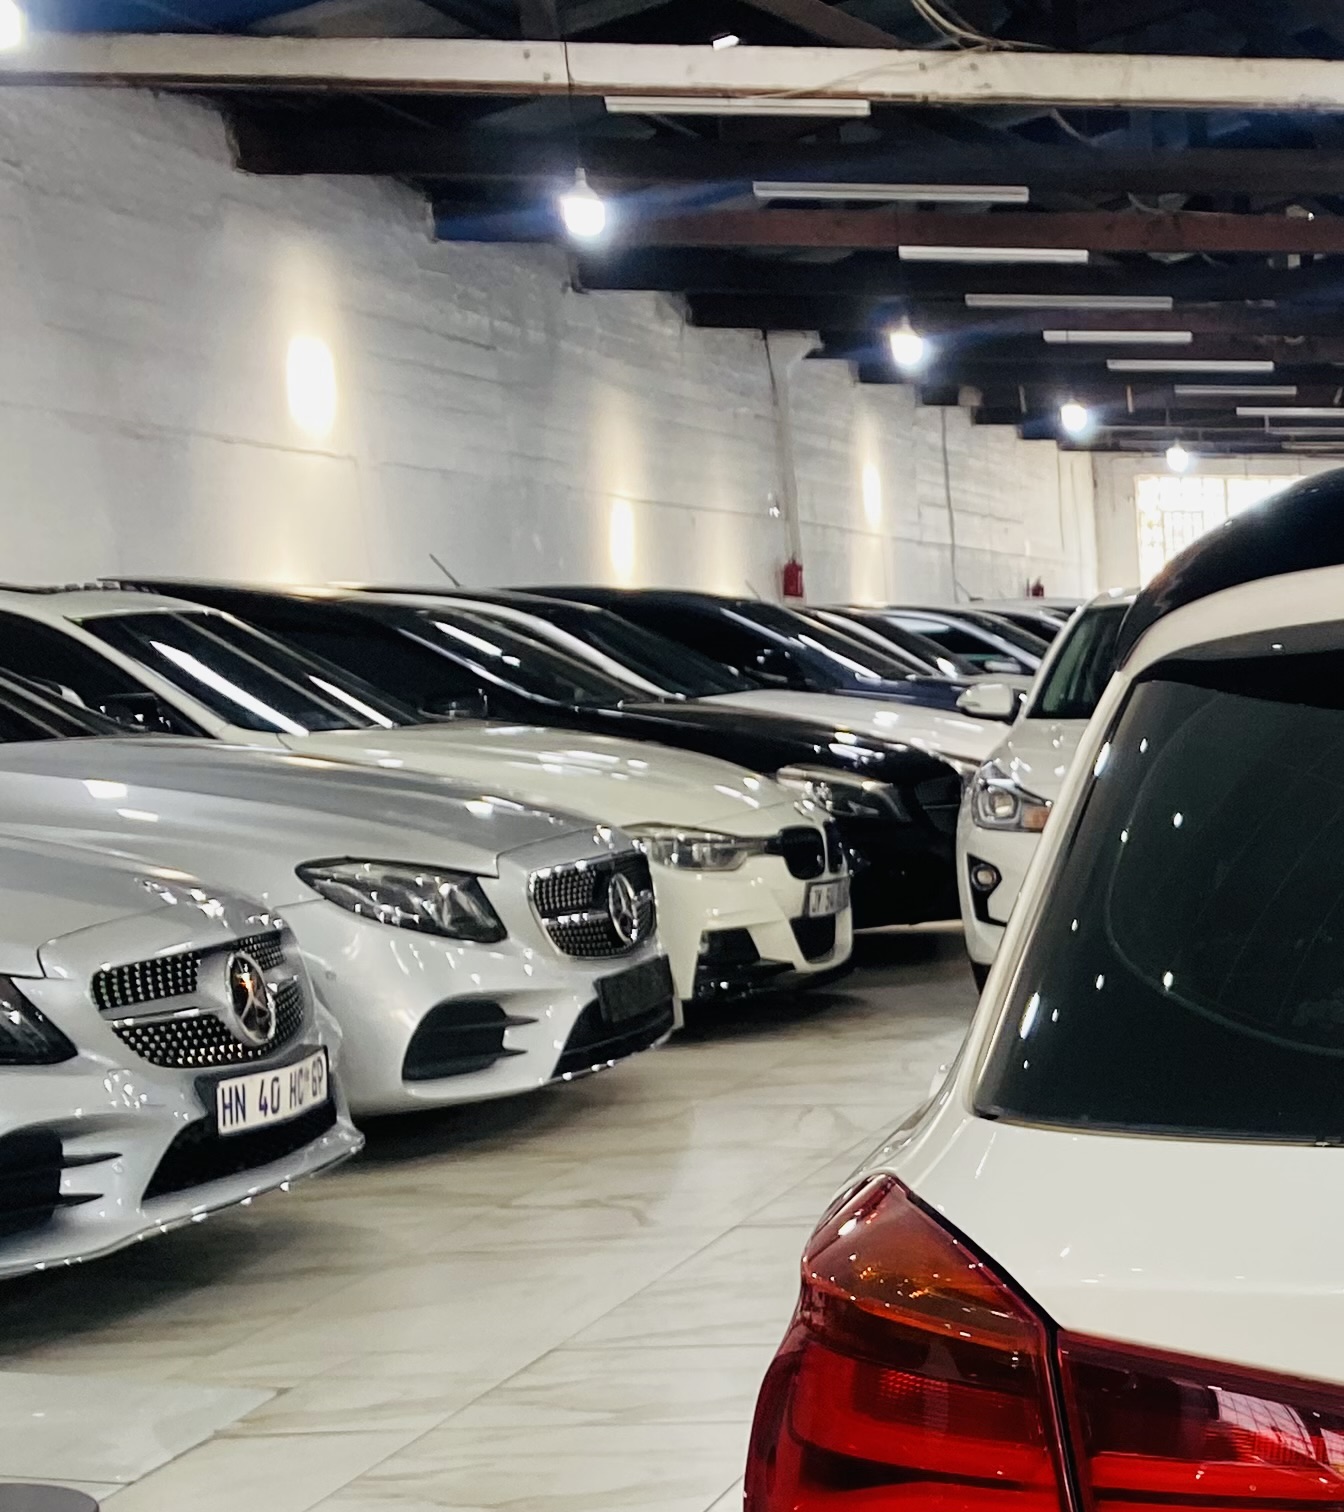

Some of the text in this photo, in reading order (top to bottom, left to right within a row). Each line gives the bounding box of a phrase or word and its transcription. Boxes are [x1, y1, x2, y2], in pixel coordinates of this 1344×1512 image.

[221, 1083, 246, 1127] HN
[258, 1076, 281, 1118] 40
[289, 1068, 305, 1110] HC
